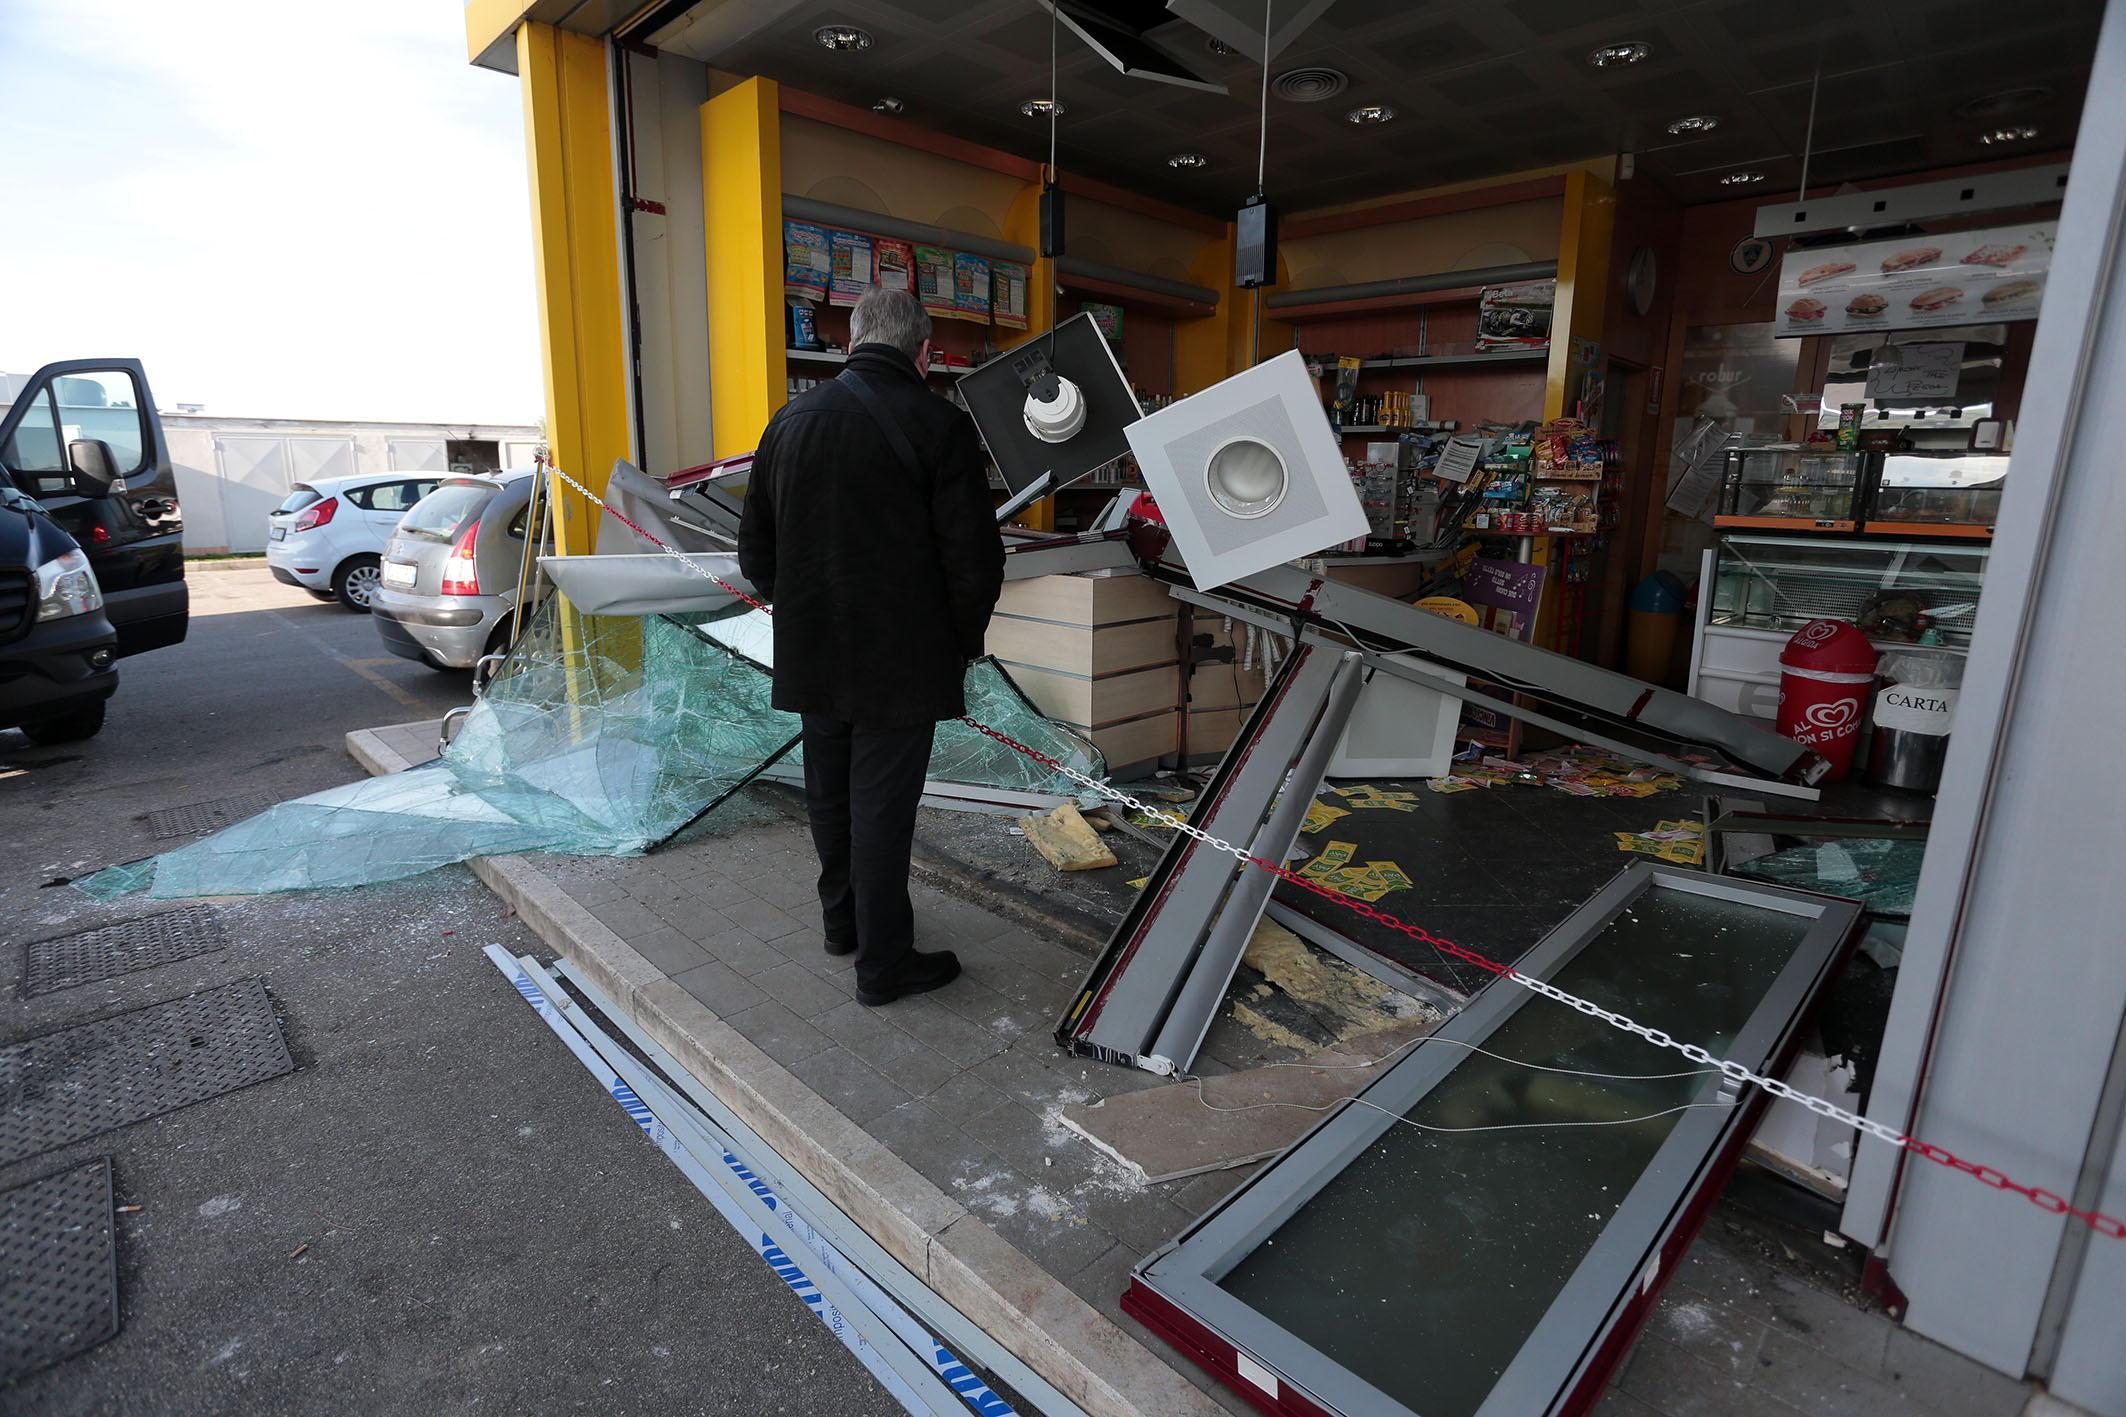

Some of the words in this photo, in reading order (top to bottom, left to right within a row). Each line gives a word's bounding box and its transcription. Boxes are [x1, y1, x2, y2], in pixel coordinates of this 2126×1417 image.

[1698, 362, 1743, 383] robur
[1886, 692, 1947, 713] CARTA
[1793, 721, 1812, 735] AL
[1820, 729, 1834, 742] SI
